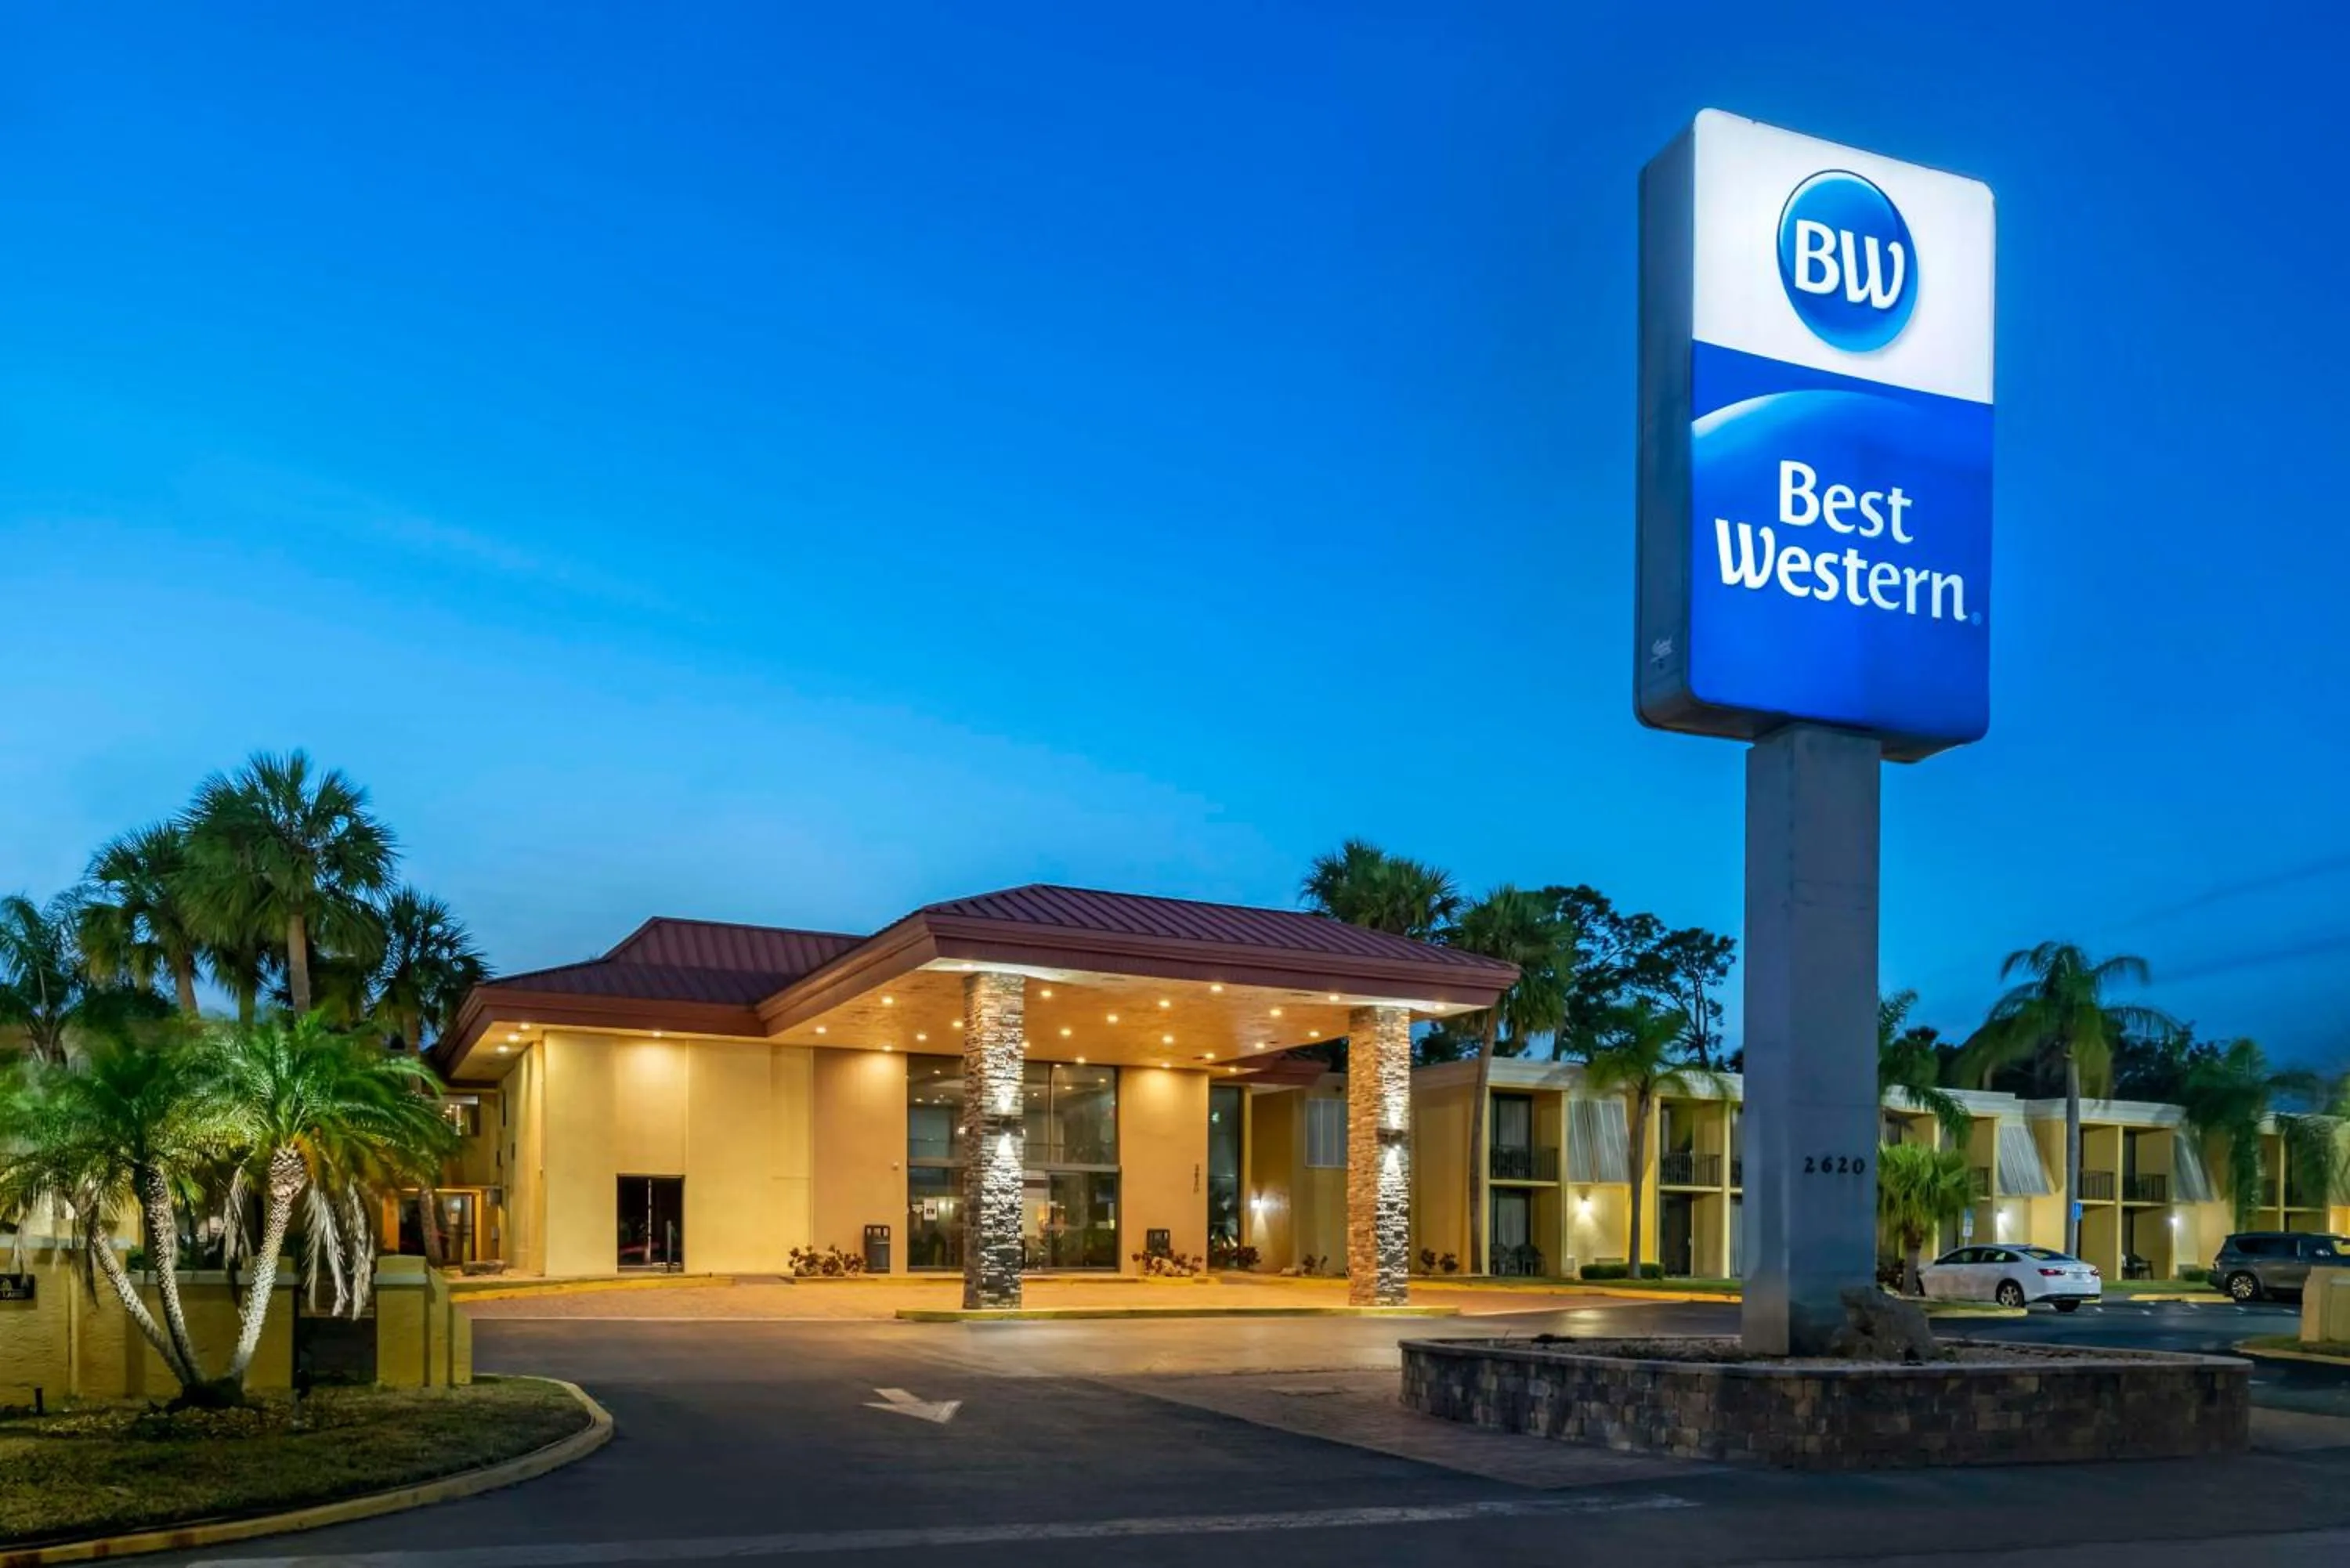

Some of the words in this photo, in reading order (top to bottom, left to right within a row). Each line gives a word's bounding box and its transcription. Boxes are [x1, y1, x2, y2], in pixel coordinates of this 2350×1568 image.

[1795, 219, 1905, 310] BW
[1779, 459, 1914, 544] Best
[1715, 517, 1968, 622] Western
[1803, 1155, 1866, 1176] 2620
